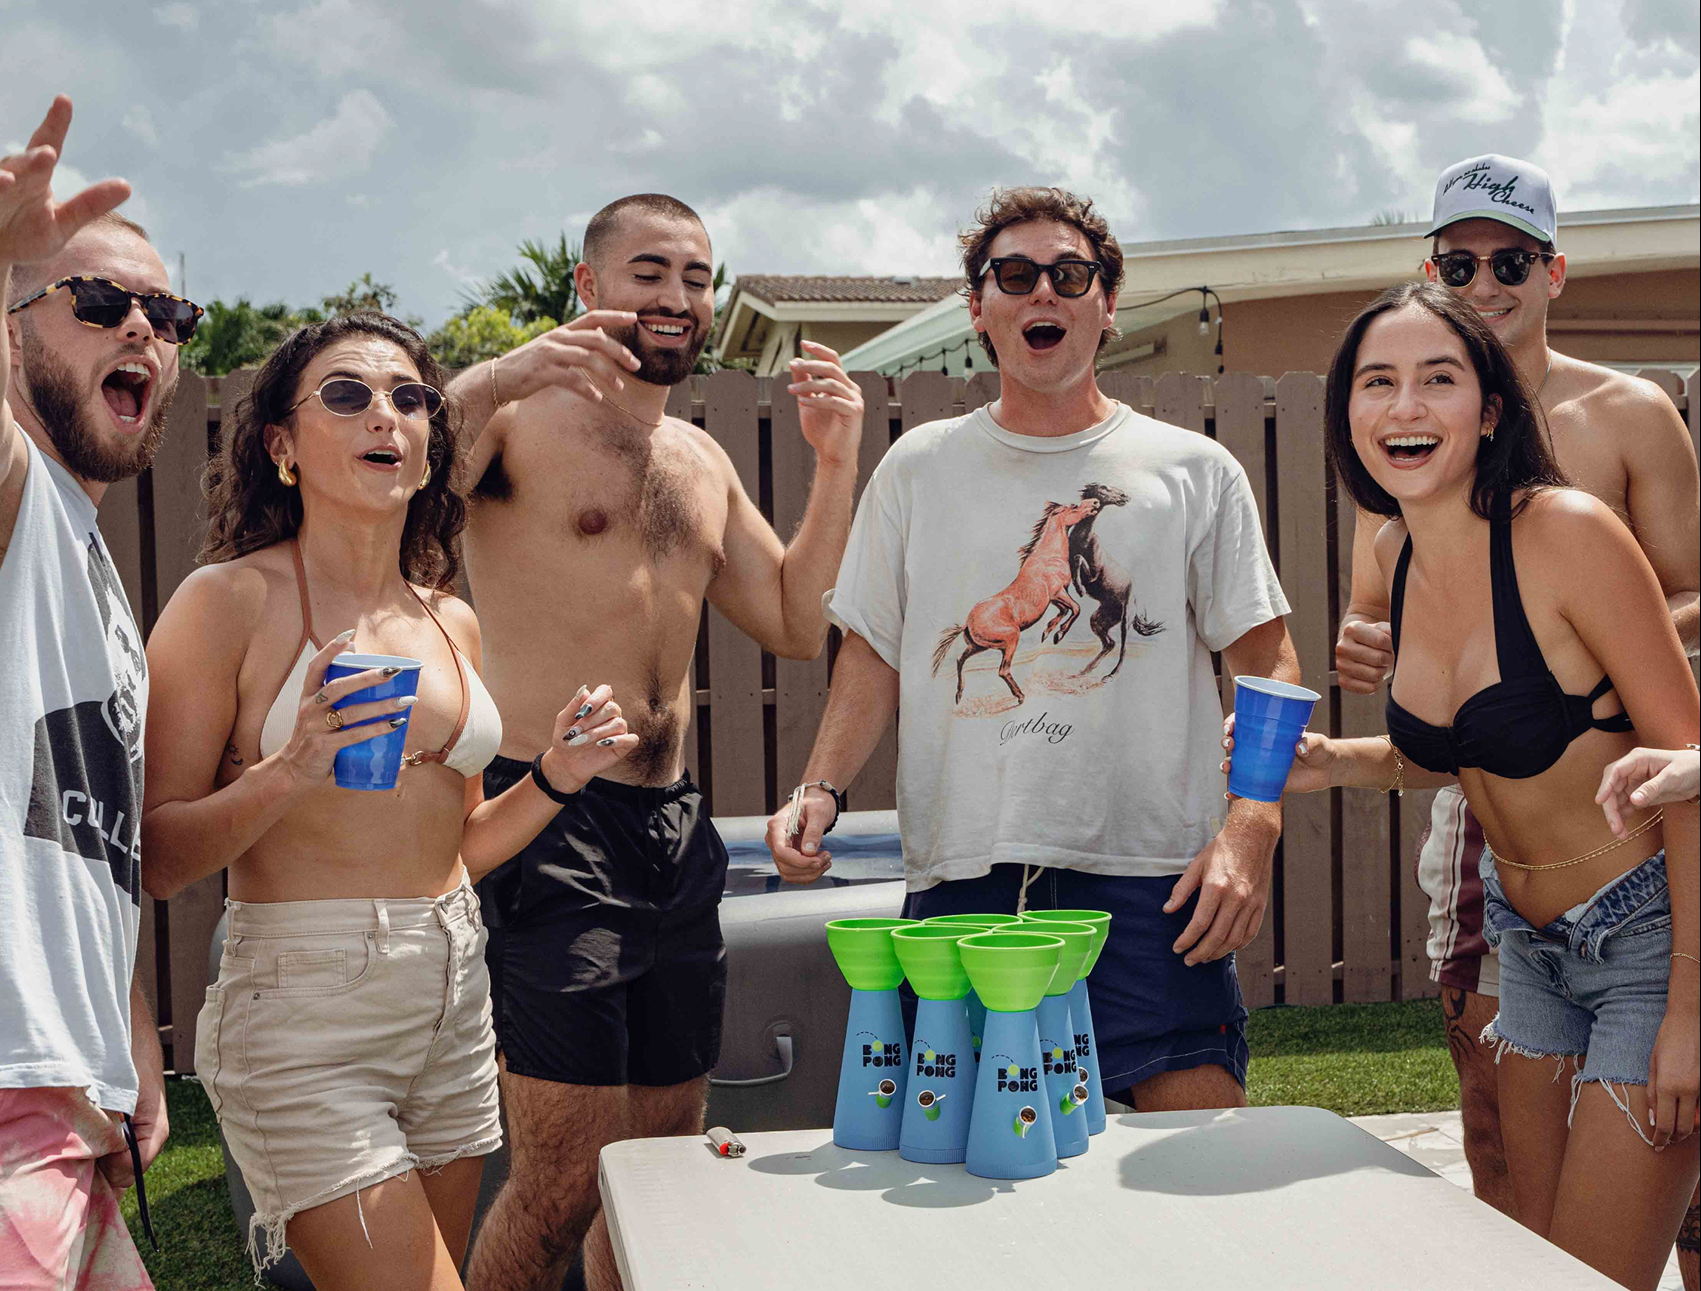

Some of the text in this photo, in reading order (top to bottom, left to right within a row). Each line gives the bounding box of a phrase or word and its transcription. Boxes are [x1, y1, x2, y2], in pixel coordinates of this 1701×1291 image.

[1462, 173, 1519, 195] High
[1491, 190, 1535, 214] Cheese
[863, 1040, 900, 1055] BONG
[1043, 1047, 1075, 1063] BONG
[863, 1055, 901, 1067] PONG
[917, 1049, 956, 1065] BONG
[917, 1065, 956, 1078] PONG
[997, 1064, 1037, 1080] BONG
[1044, 1061, 1077, 1075] PONG
[997, 1080, 1038, 1092] PONG
